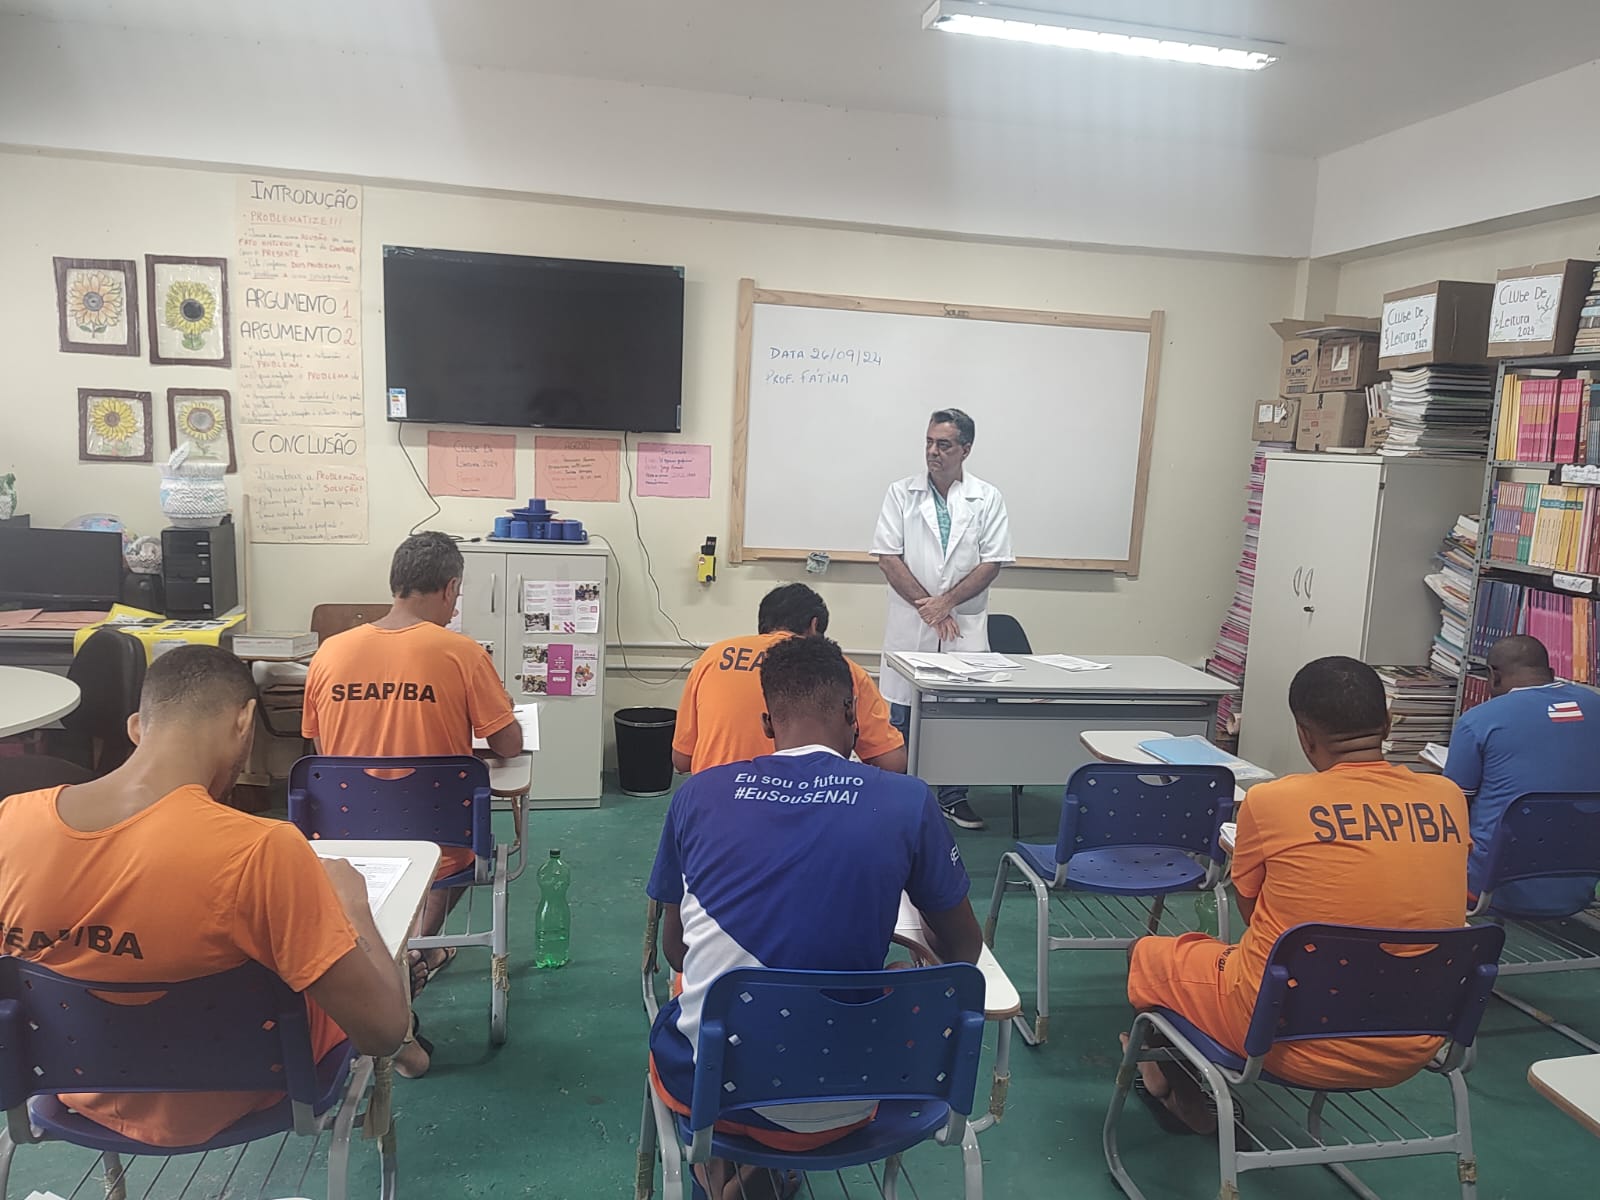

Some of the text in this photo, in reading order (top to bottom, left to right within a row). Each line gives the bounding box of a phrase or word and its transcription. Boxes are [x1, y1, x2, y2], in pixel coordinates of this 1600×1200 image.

[251, 180, 358, 210] INTRODUÇÃO
[246, 287, 352, 319] ARGUMENTO 1
[240, 321, 357, 346] ARGUMENTO 2
[769, 346, 881, 366] DATA 26/09/24
[252, 430, 357, 455] CONCLUSÃO
[331, 682, 437, 704] SEAP/BA
[734, 772, 864, 790] Eu sou o futuro
[734, 786, 859, 805] #EuSouSENAI
[1309, 802, 1462, 844] SEAP/BA
